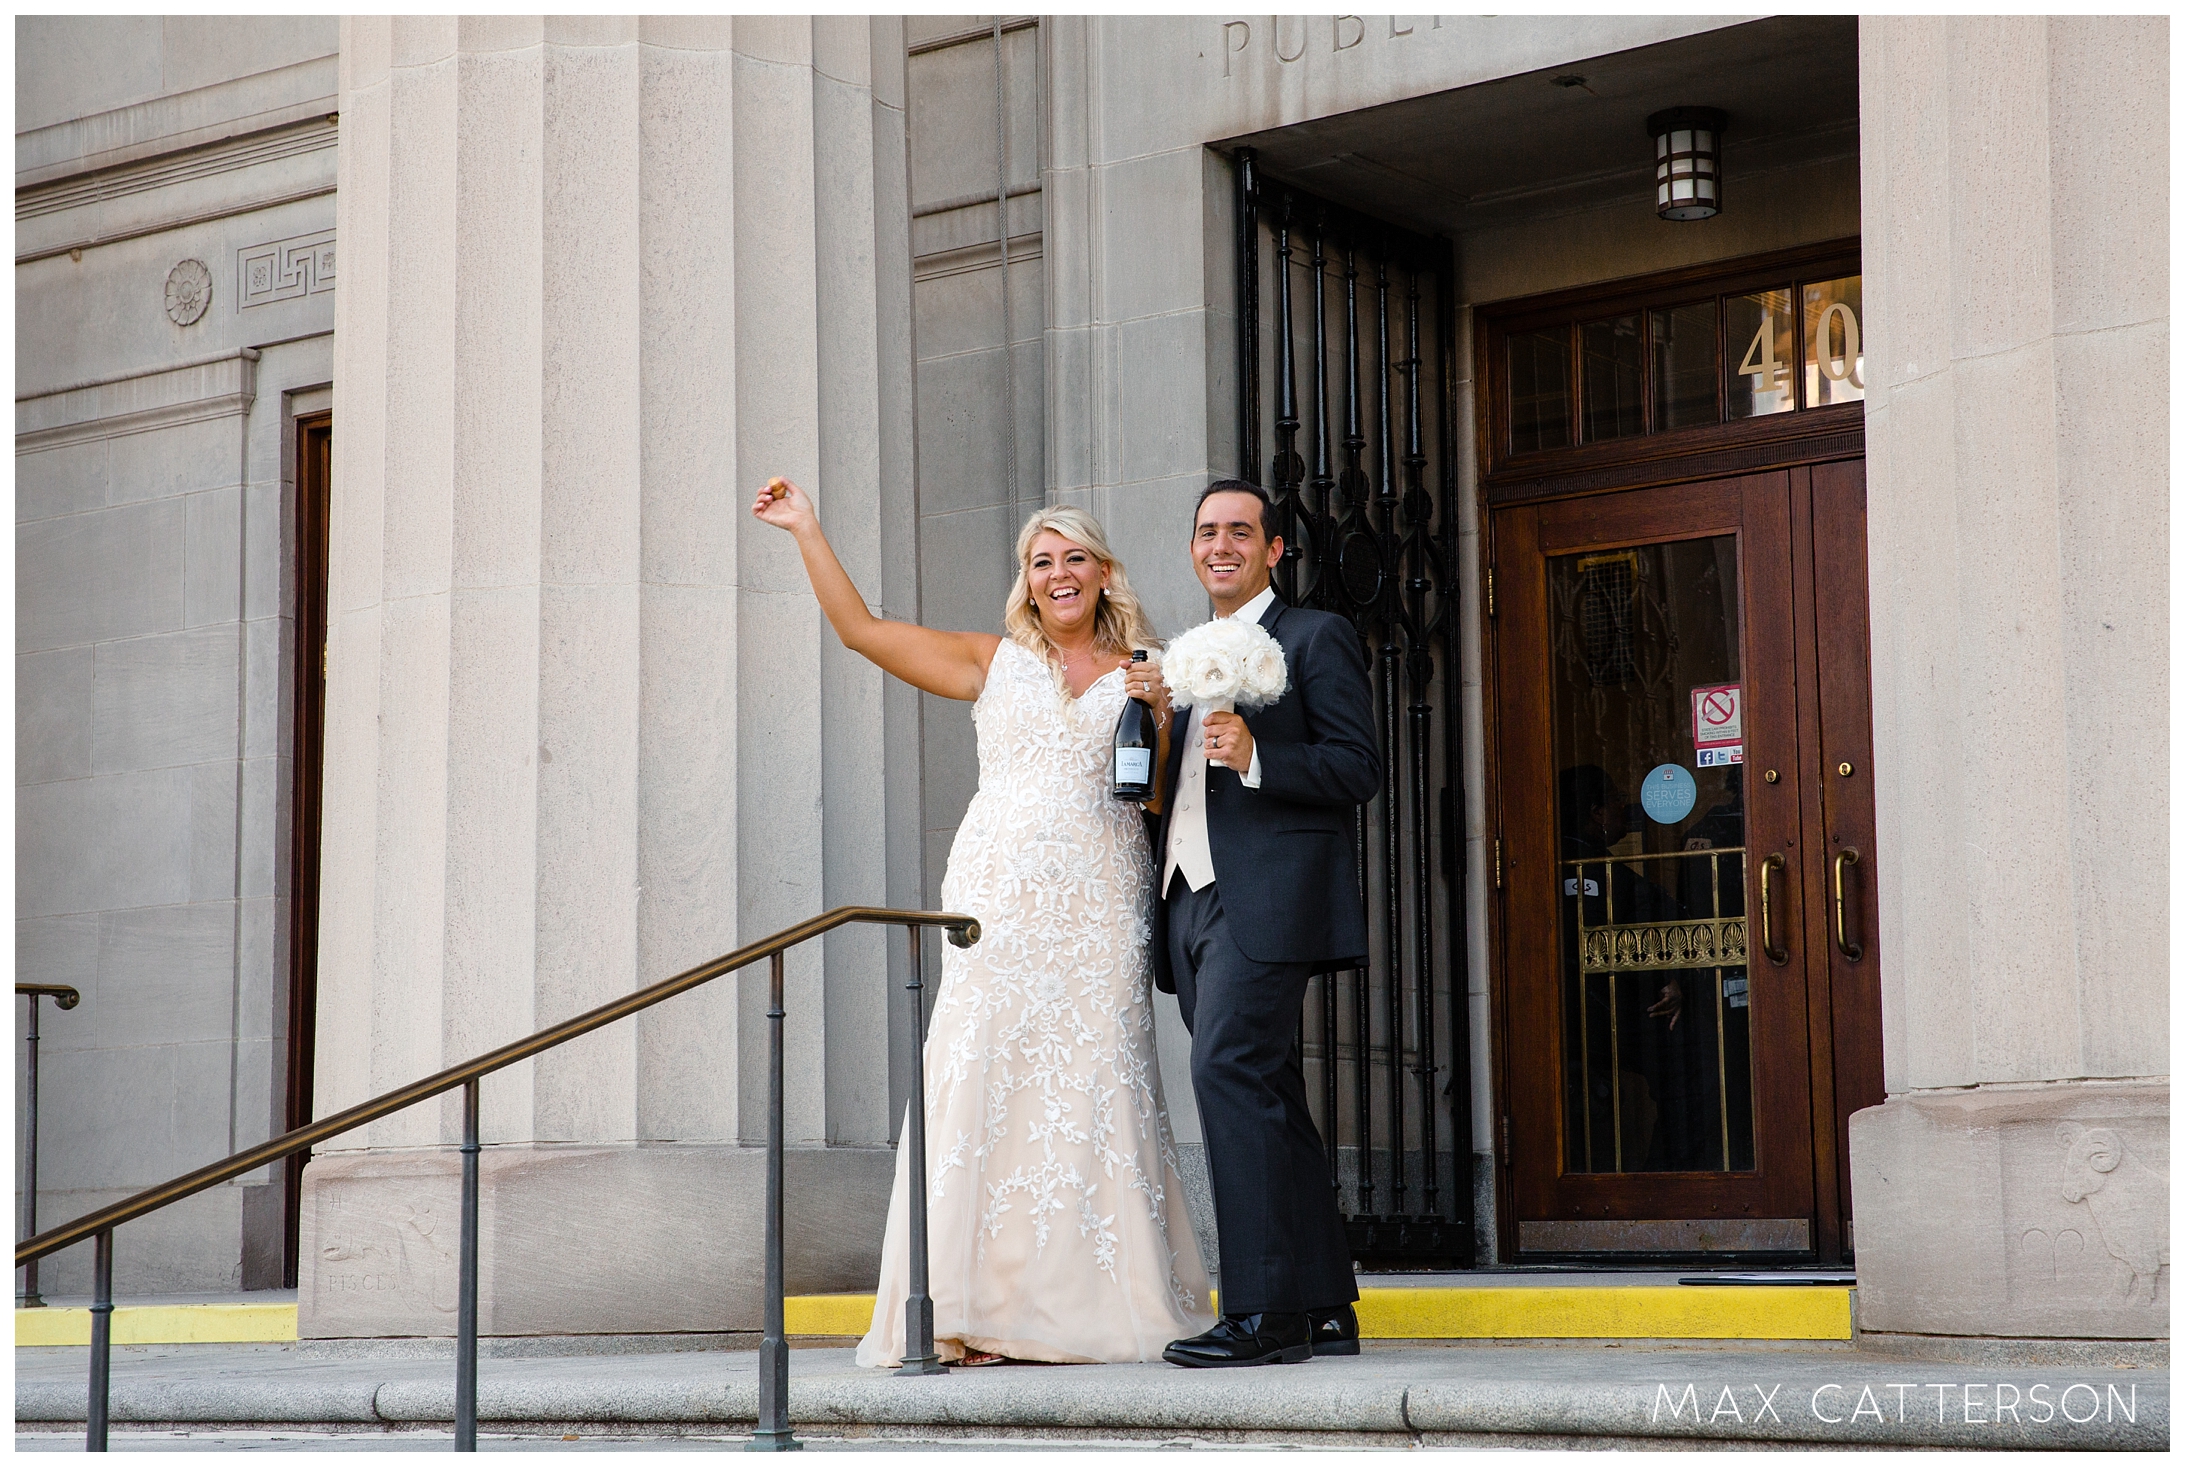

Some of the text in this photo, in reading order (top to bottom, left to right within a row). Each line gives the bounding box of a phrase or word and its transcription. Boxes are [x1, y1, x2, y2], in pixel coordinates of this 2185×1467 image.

[1738, 302, 1860, 393] 40
[1646, 789, 1691, 800] SERVES
[1646, 799, 1691, 808] EVERYONE
[328, 1274, 396, 1292] PISCES
